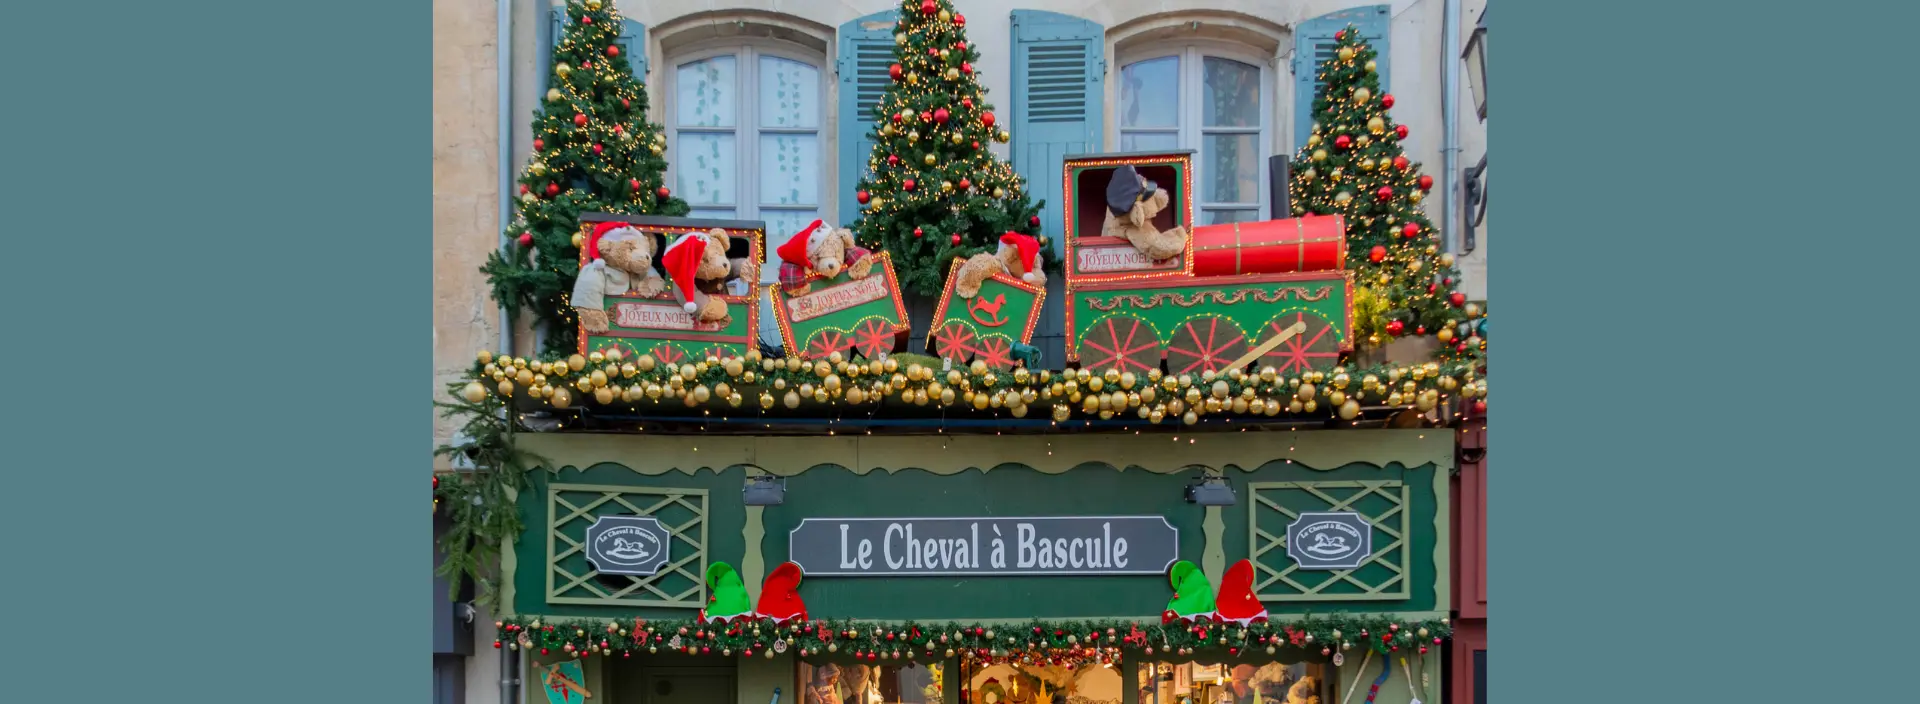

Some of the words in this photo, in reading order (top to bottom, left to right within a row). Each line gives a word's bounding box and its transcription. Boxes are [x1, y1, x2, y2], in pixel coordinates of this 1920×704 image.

[1084, 254, 1121, 269] JOYEUX
[623, 309, 661, 324] JOYEUX
[599, 535, 608, 543] Le
[608, 528, 628, 538] Cheval
[634, 528, 657, 544] Bascule
[1300, 531, 1309, 539] Le
[1308, 523, 1329, 533] Cheval
[1335, 523, 1358, 537] Bascule
[839, 524, 873, 570] Le
[883, 522, 980, 570] Cheval
[990, 523, 1007, 568] à
[1016, 521, 1129, 569] Bascule
